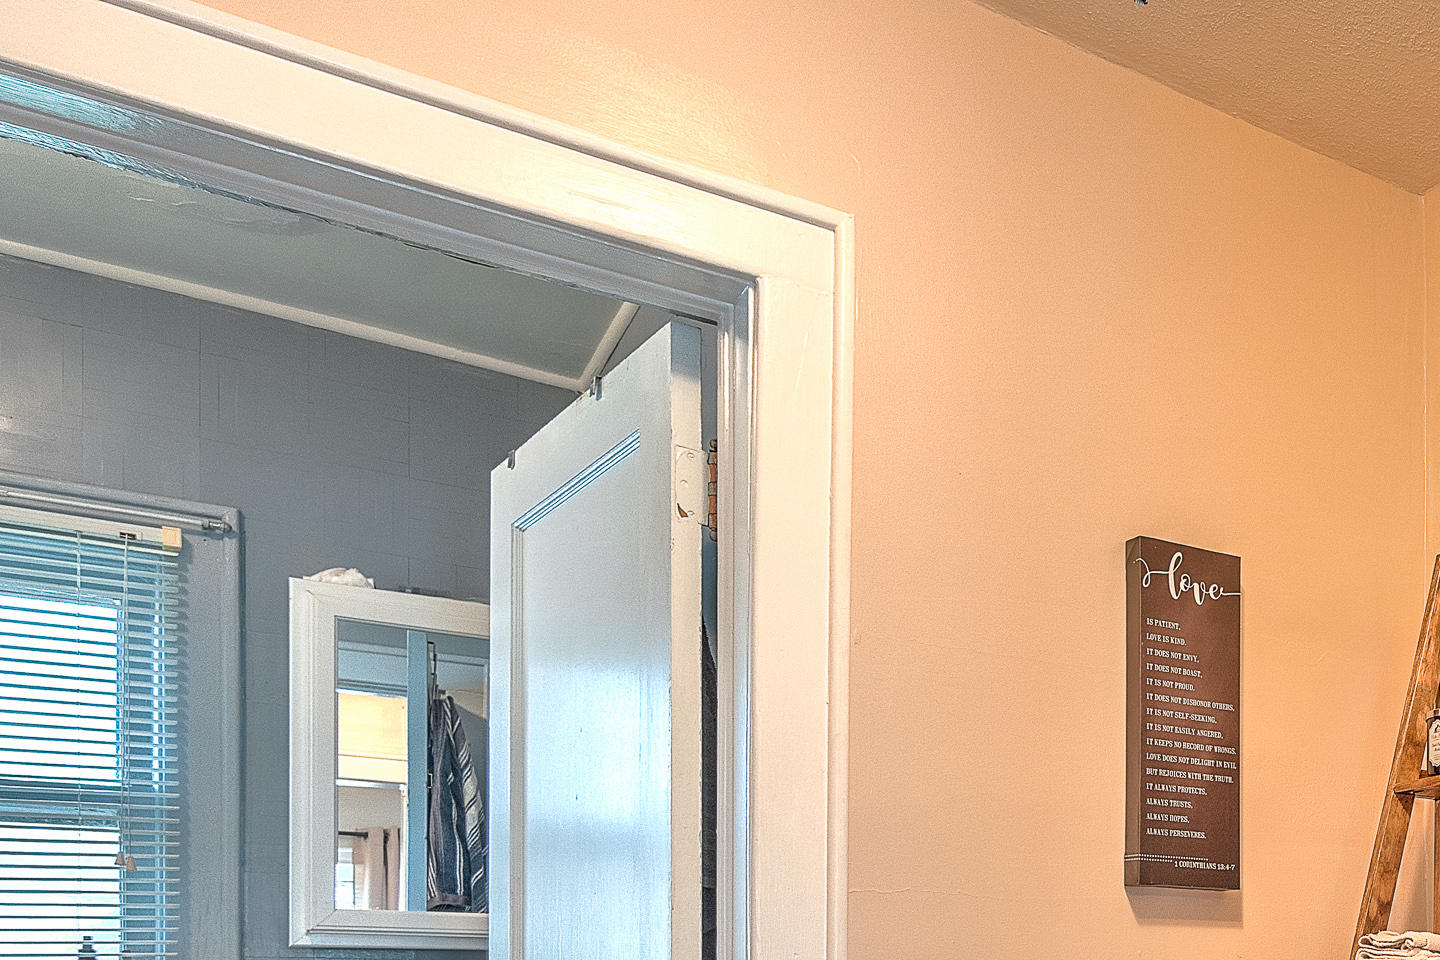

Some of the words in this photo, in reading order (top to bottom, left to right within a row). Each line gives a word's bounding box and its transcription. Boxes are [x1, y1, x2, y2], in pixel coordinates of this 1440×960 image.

[1143, 552, 1240, 605] love
[1146, 633, 1161, 641] LOVE
[1154, 649, 1169, 658] DOES
[1170, 651, 1182, 660] NOT
[1154, 664, 1169, 673] DOES
[1170, 666, 1182, 675] NOT
[1162, 680, 1173, 688] NOT
[1154, 694, 1169, 702] DOES
[1170, 696, 1182, 704] NOT
[1183, 698, 1211, 708] DISHONOR
[1162, 710, 1173, 718] NOT
[1162, 725, 1173, 733] NOT
[1174, 726, 1195, 736] EASILY
[1154, 738, 1173, 747] KEEPS
[1182, 742, 1204, 751] RECORD
[1162, 754, 1177, 763] DOES
[1178, 756, 1189, 764] NOT
[1190, 757, 1215, 767] DELIGHT
[1216, 760, 1223, 768] IN
[1158, 769, 1187, 779] REJOICES
[1187, 772, 1202, 780] WITH
[1202, 773, 1214, 781] THE
[1146, 782, 1153, 790] IT
[1154, 783, 1177, 792] ALWAYS
[1145, 798, 1169, 806] ALWAYS
[1145, 812, 1169, 821] ALWAYS
[1145, 827, 1169, 836] ALWAYS
[1178, 860, 1217, 870] CORINTHIANS
